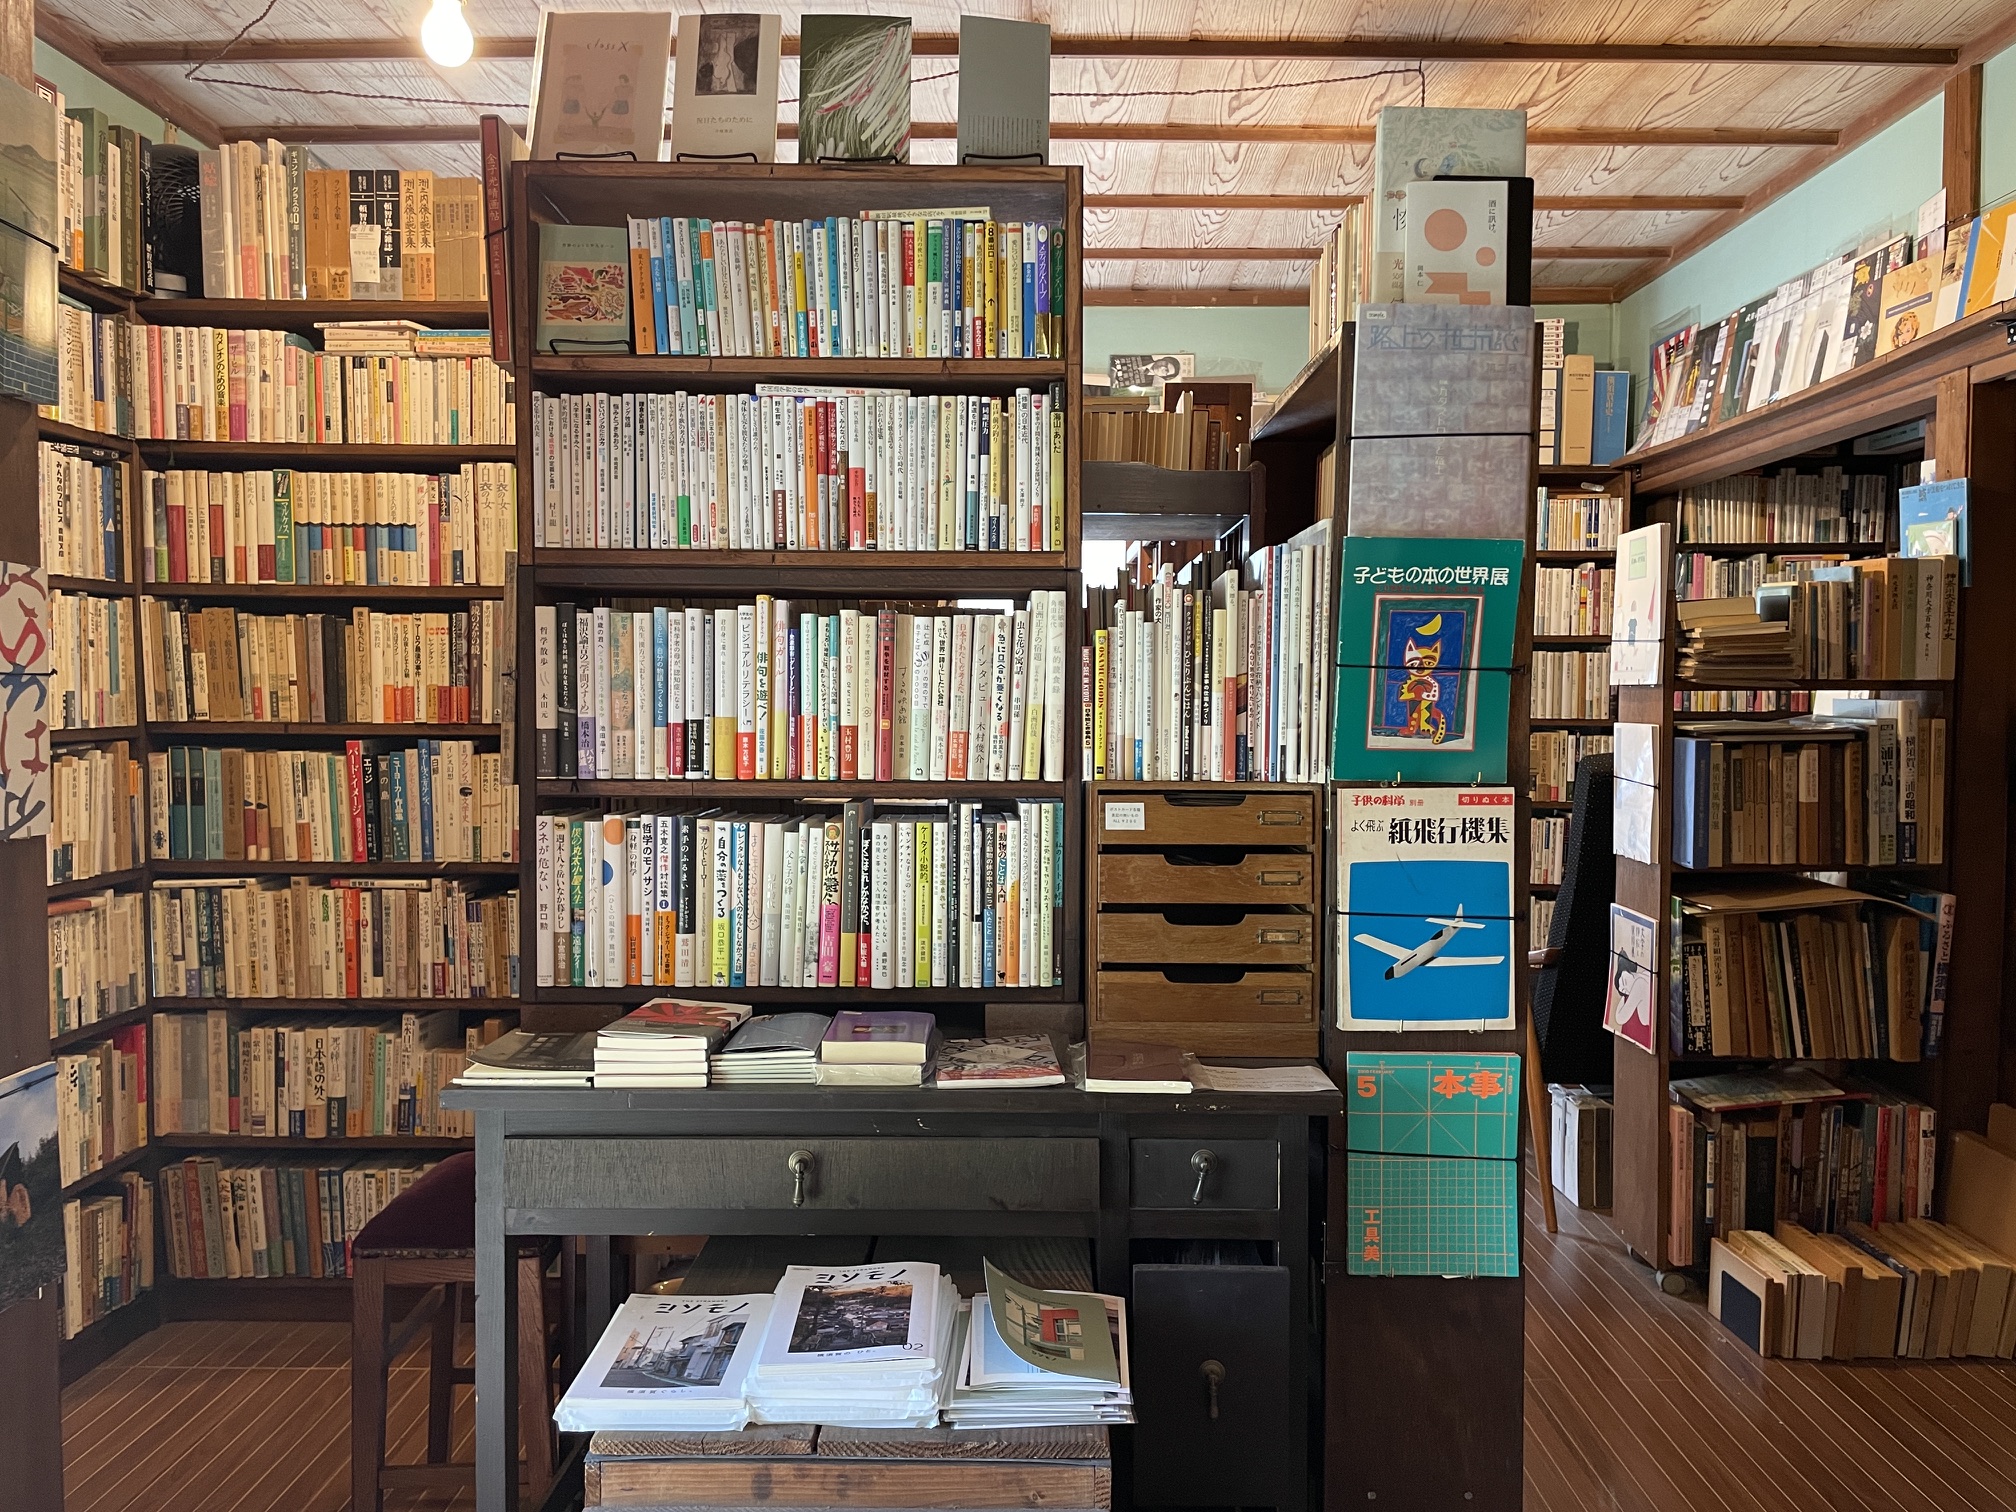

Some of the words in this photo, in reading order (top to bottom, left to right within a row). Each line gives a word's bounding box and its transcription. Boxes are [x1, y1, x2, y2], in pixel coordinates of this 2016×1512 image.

[486, 152, 500, 222] 金子光晴画帖
[216, 332, 225, 407] カメレオンのための音楽
[56, 460, 64, 524] みんなのプロレス
[479, 465, 495, 510] 白衣の女
[497, 465, 511, 511] 白衣の女
[1353, 566, 1510, 586] 子どもの本の世界展
[471, 605, 480, 655] 鏡のなかの鏡
[540, 626, 549, 667] 哲学散歩
[775, 620, 786, 677] 俳句ガール
[1014, 621, 1026, 676] 虫と花の寓話
[674, 619, 682, 710] 脳科学者の母が、認知症になる
[978, 644, 988, 718] インタビュー
[996, 634, 1006, 722] 急に具合が悪くなる
[1173, 634, 1181, 686] 私たちのお弁当
[540, 693, 549, 719] 木田元
[581, 721, 590, 748] 橋本治
[975, 722, 986, 764] 木村俊介
[1880, 734, 1894, 787] 三浦半島
[363, 758, 373, 785] エッジ
[1905, 736, 1916, 820] 横須賀・三浦の昭和
[1350, 819, 1384, 832] よく飛ぶ
[1351, 795, 1406, 807] 子供の科学
[1461, 796, 1511, 804] 切りぬく本
[538, 821, 550, 892] タネが危ない
[920, 826, 929, 884] ケータイ小説的。
[1388, 817, 1511, 845] 紙飛行機集
[642, 823, 653, 897] 哲学のモノサシ
[660, 820, 669, 898] 五木寛之傑作対談集
[681, 825, 690, 890] 素手のふるまい
[717, 836, 728, 918] 自分の薬をつくる
[736, 832, 745, 972] レンタルなんもしない人のなんもしなかった話
[718, 924, 726, 954] 坂口恭平
[314, 1038, 327, 1102] 日本語の外へ
[1357, 1076, 1377, 1098] 5
[1432, 1069, 1504, 1099] 本事
[1363, 1209, 1381, 1262] 工具美
[815, 1268, 908, 1285] ヨソモノ
[655, 1302, 750, 1315] ヨソモノ
